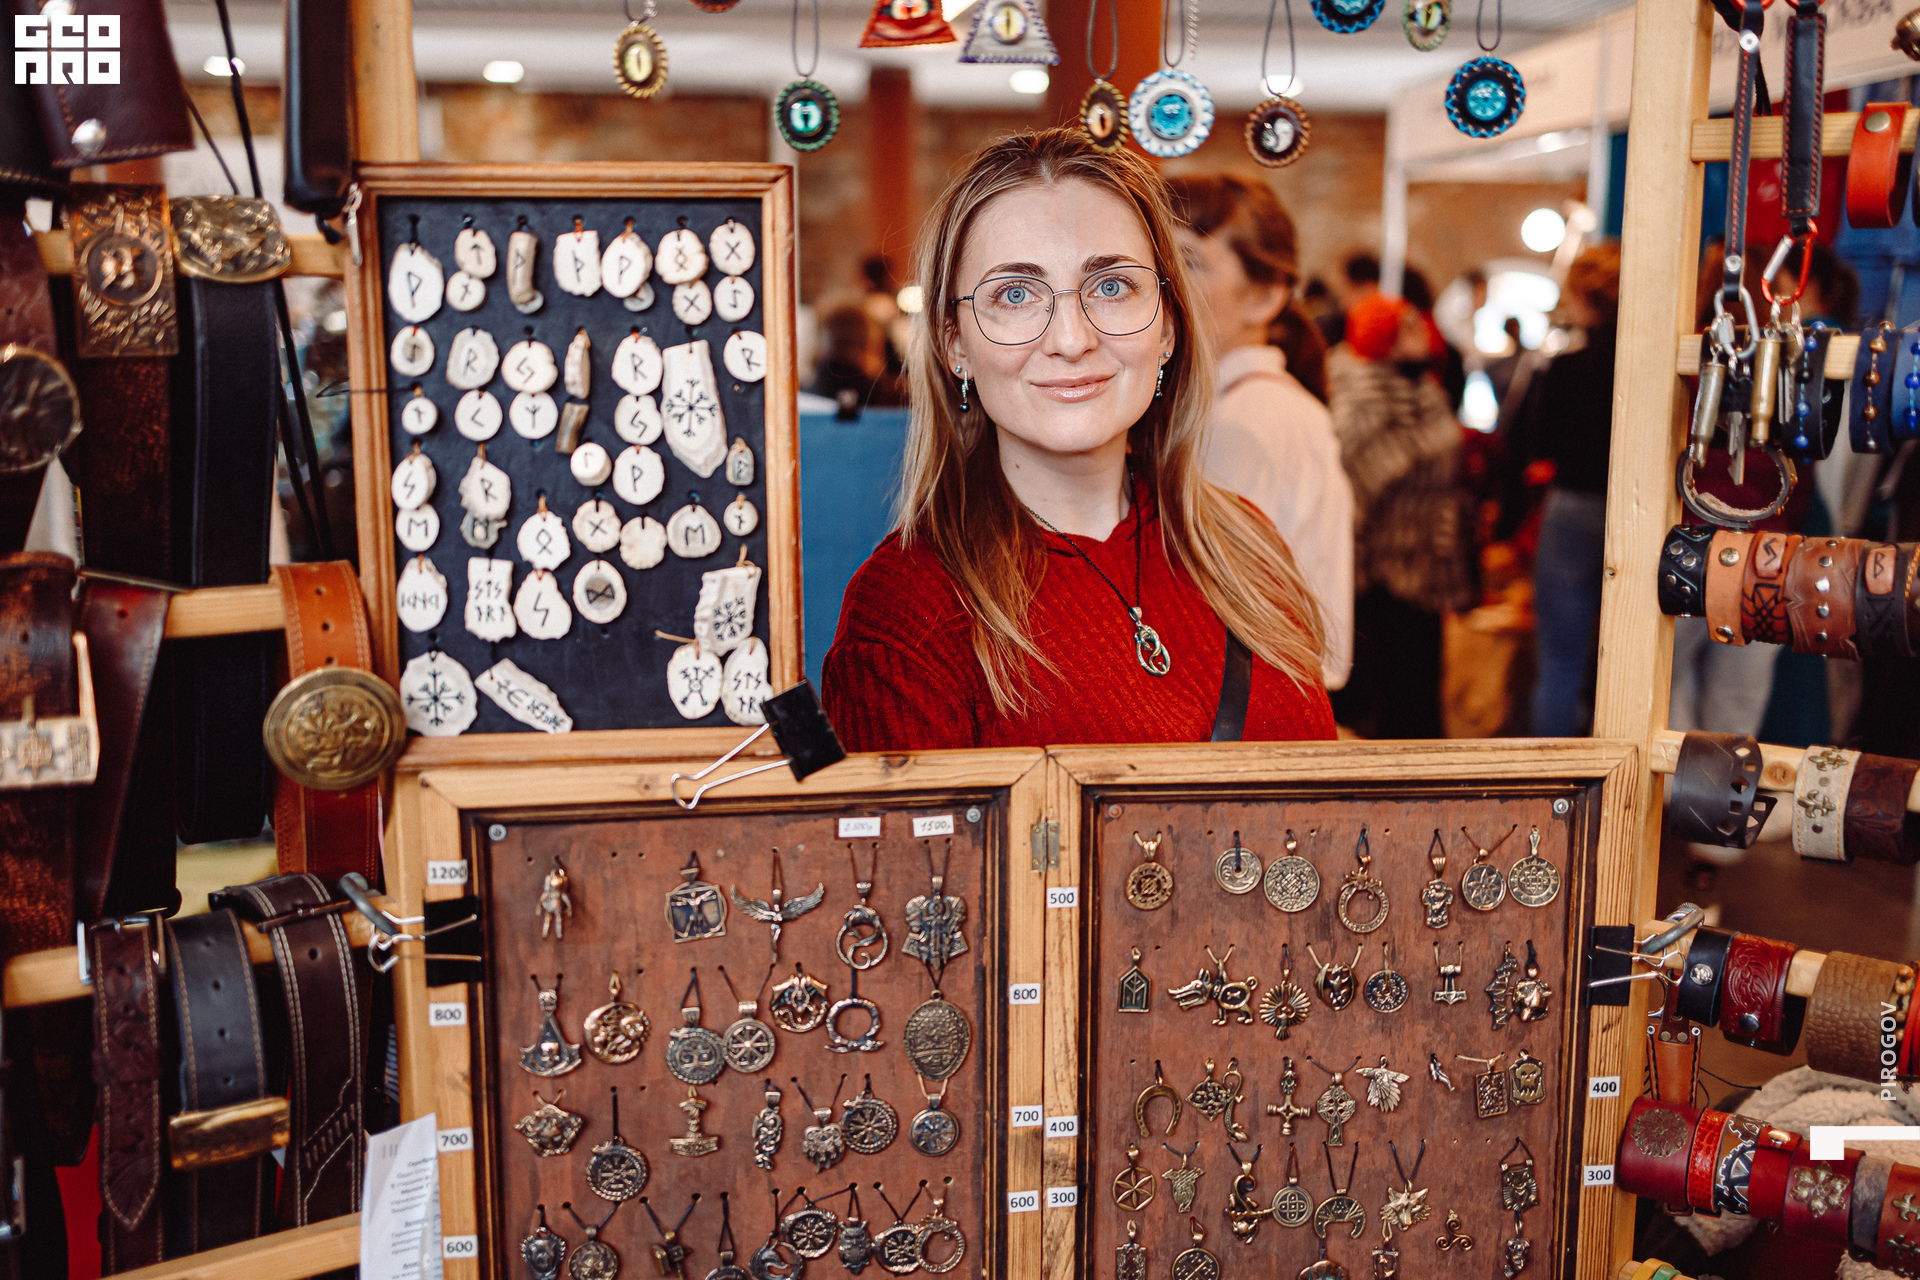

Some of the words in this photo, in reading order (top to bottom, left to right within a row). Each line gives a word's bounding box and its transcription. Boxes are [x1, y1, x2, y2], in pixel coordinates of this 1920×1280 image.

[431, 867, 467, 879] 1200
[1050, 893, 1074, 904] 500
[1013, 989, 1037, 1000] 800
[434, 1008, 461, 1020] 800
[1593, 1081, 1617, 1093] 400
[1015, 1111, 1039, 1122] 700
[1050, 1121, 1074, 1132] 400
[441, 1133, 468, 1146] 700
[1588, 1169, 1611, 1181] 300
[1011, 1196, 1035, 1208] 600
[1051, 1192, 1075, 1203] 300
[446, 1240, 473, 1252] 600
